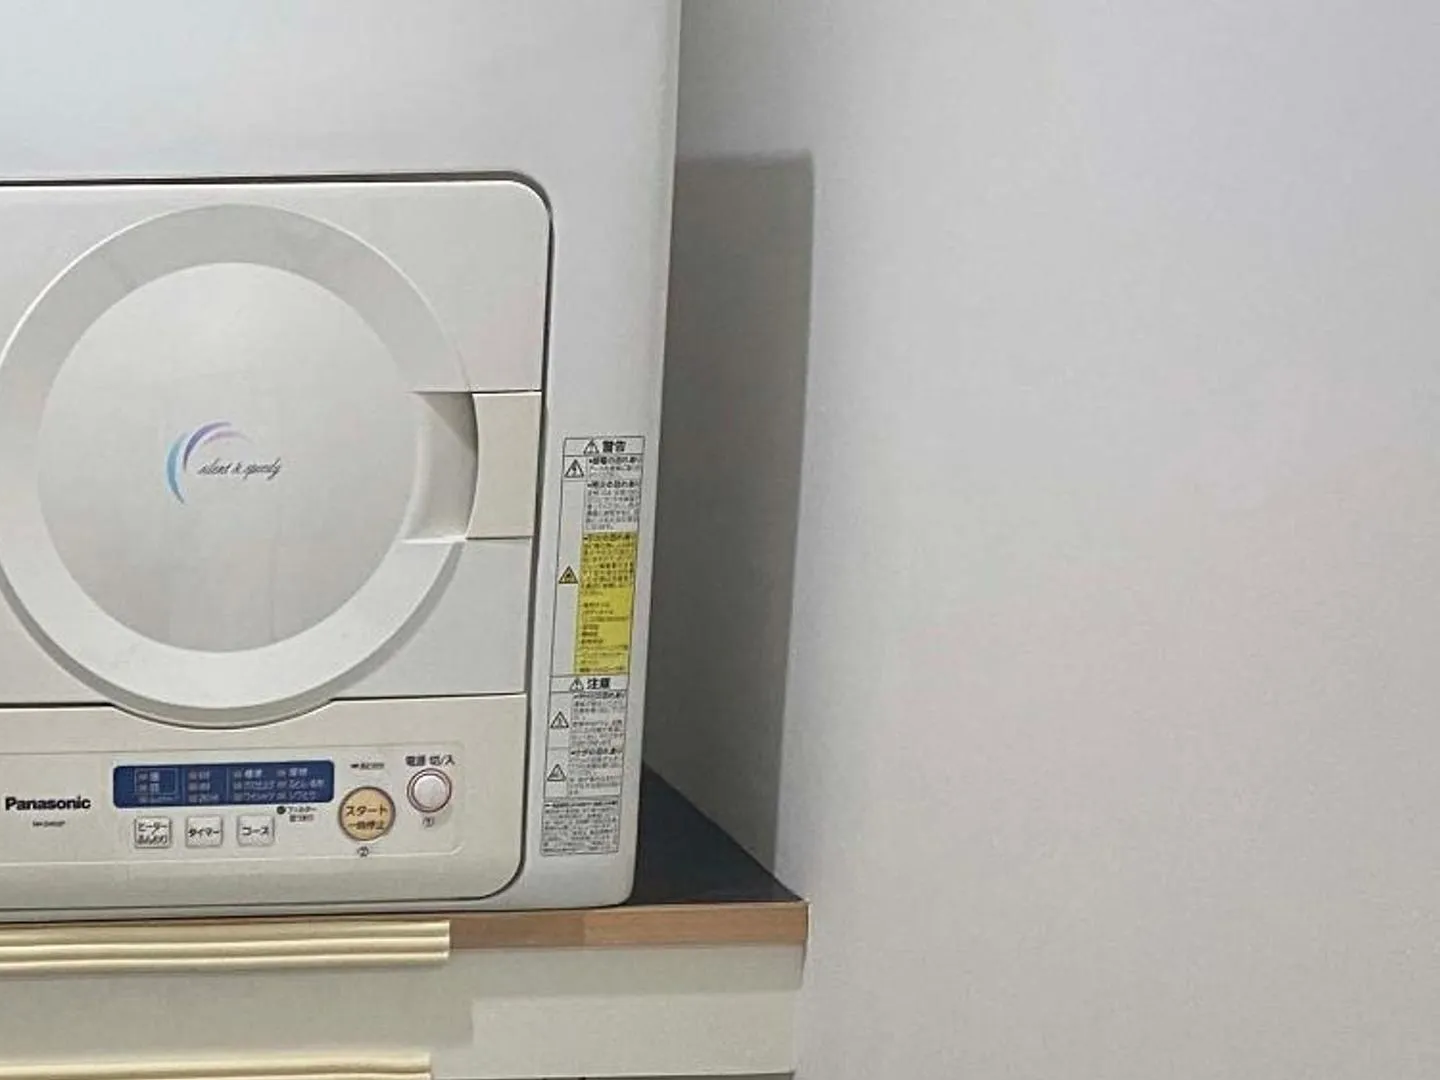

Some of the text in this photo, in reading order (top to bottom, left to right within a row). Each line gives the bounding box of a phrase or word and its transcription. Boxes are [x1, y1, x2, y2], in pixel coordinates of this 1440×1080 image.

[587, 677, 610, 690] 注意
[5, 795, 91, 811] Panasonic
[346, 804, 388, 816] スタート
[187, 827, 220, 838] タイマー
[242, 826, 270, 836] コース
